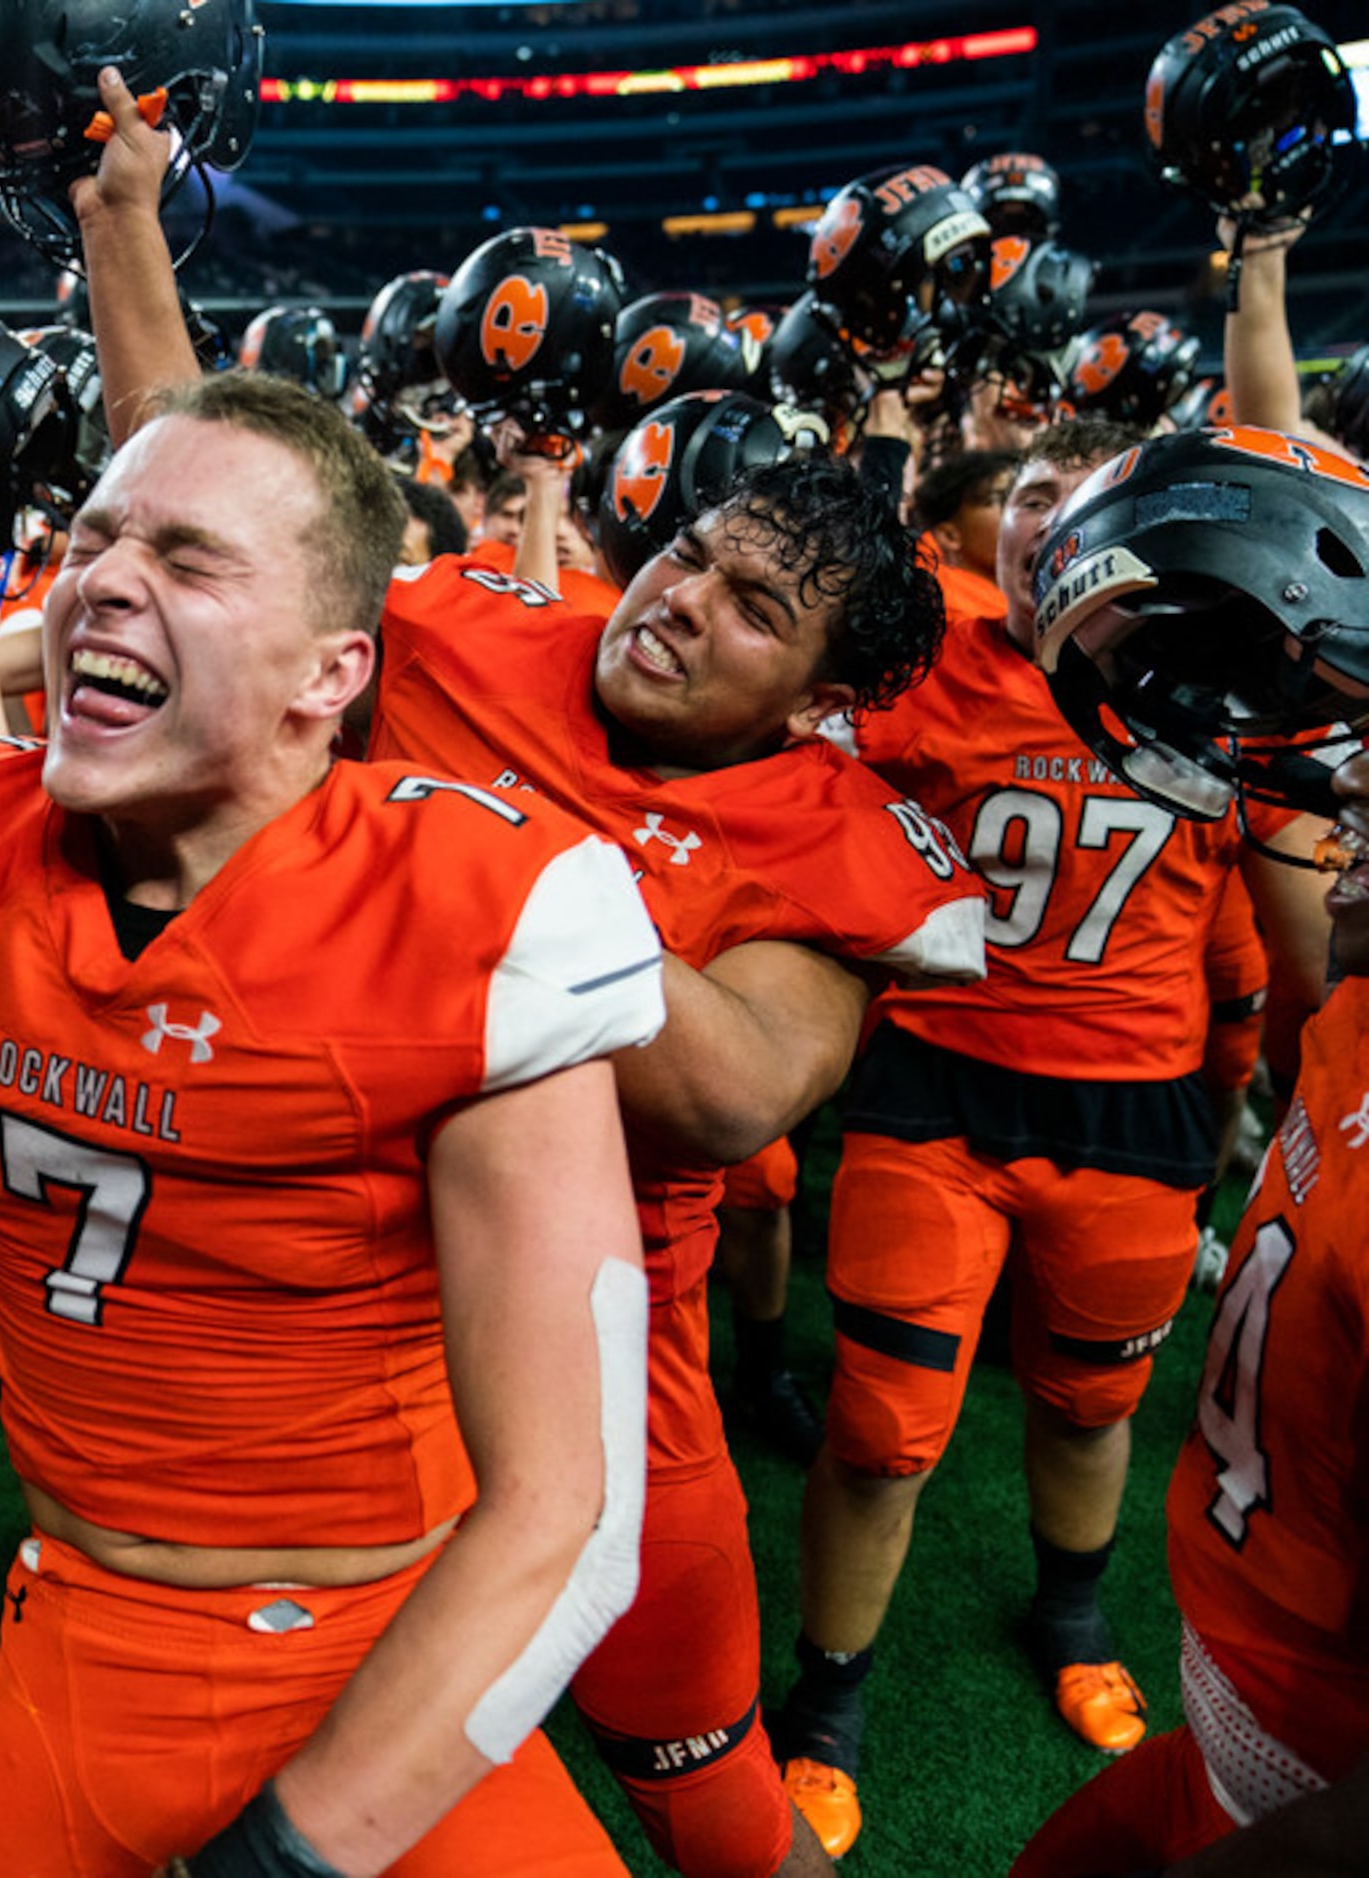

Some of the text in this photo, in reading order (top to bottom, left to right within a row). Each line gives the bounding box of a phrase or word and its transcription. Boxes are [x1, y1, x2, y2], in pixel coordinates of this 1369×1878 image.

[481, 275, 549, 371] R
[968, 786, 1176, 964] 97
[1195, 1213, 1297, 1554] 4
